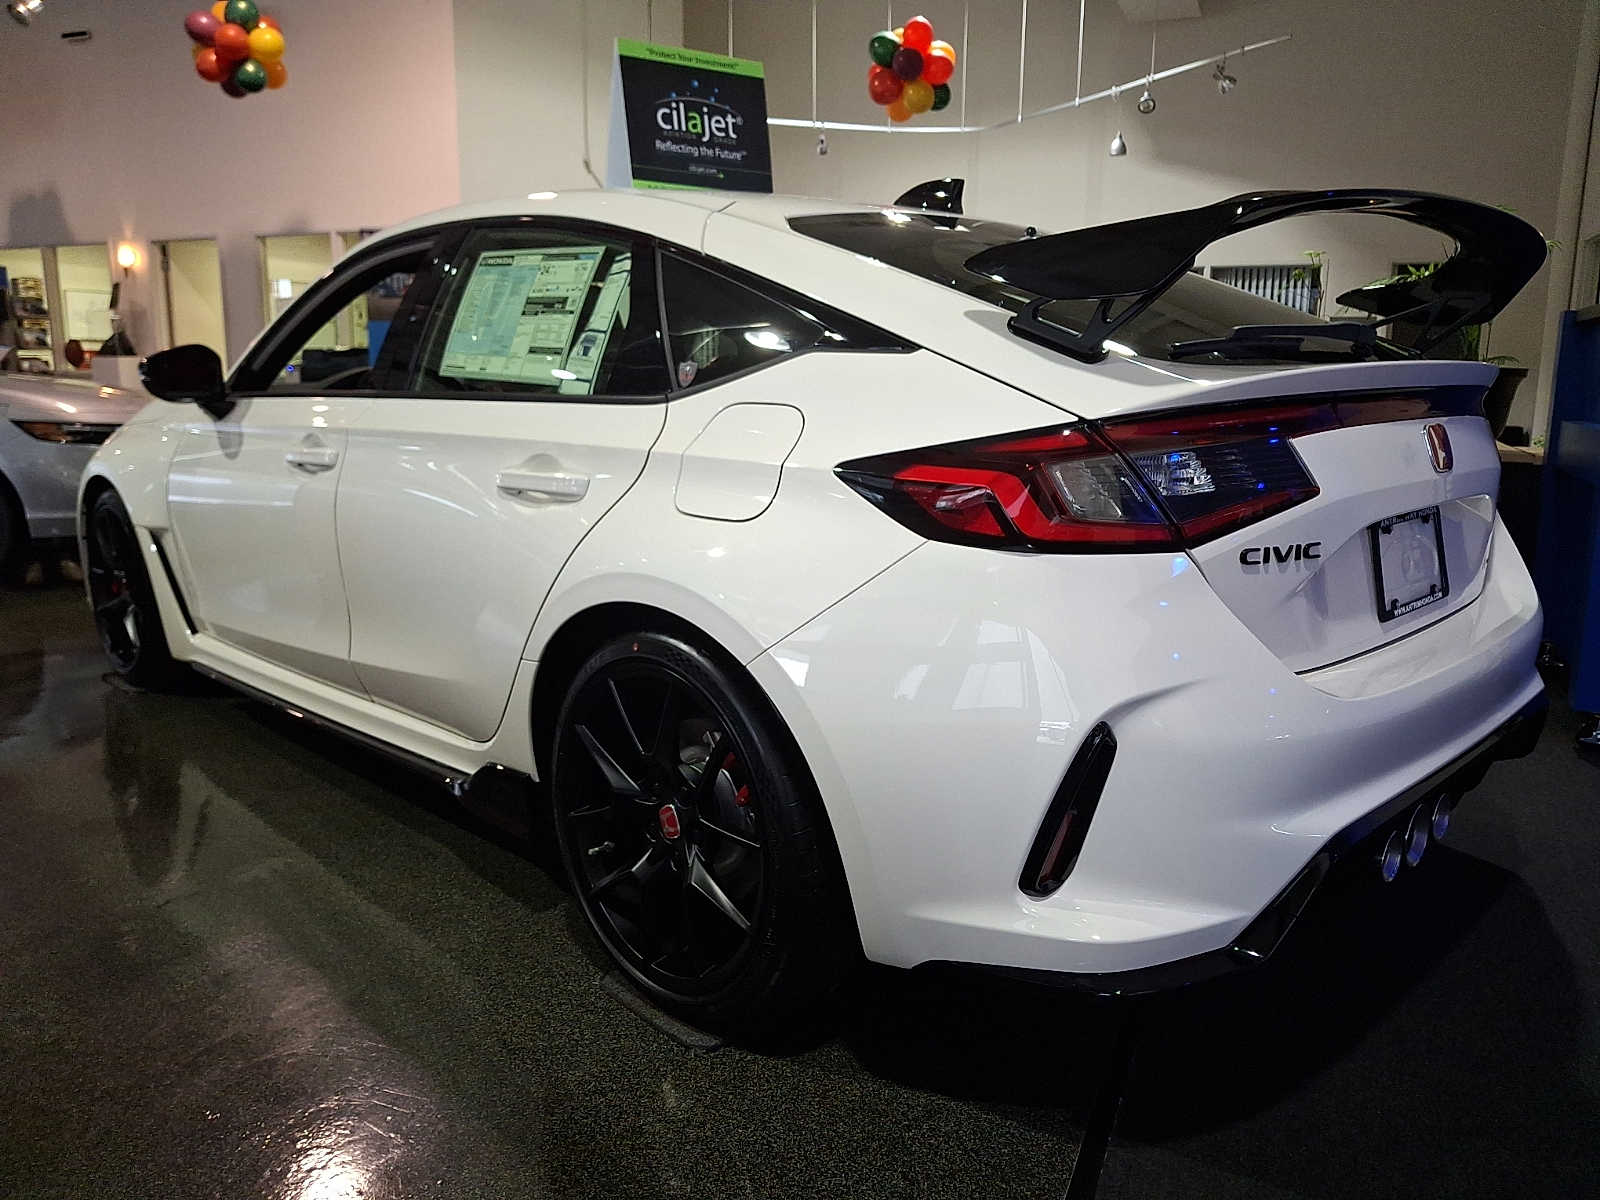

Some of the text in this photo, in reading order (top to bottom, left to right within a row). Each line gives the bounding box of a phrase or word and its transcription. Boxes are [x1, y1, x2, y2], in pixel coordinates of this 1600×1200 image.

[656, 101, 737, 142] cilajet
[656, 139, 742, 161] Reflecting the Future
[1239, 541, 1322, 566] CIVIC
